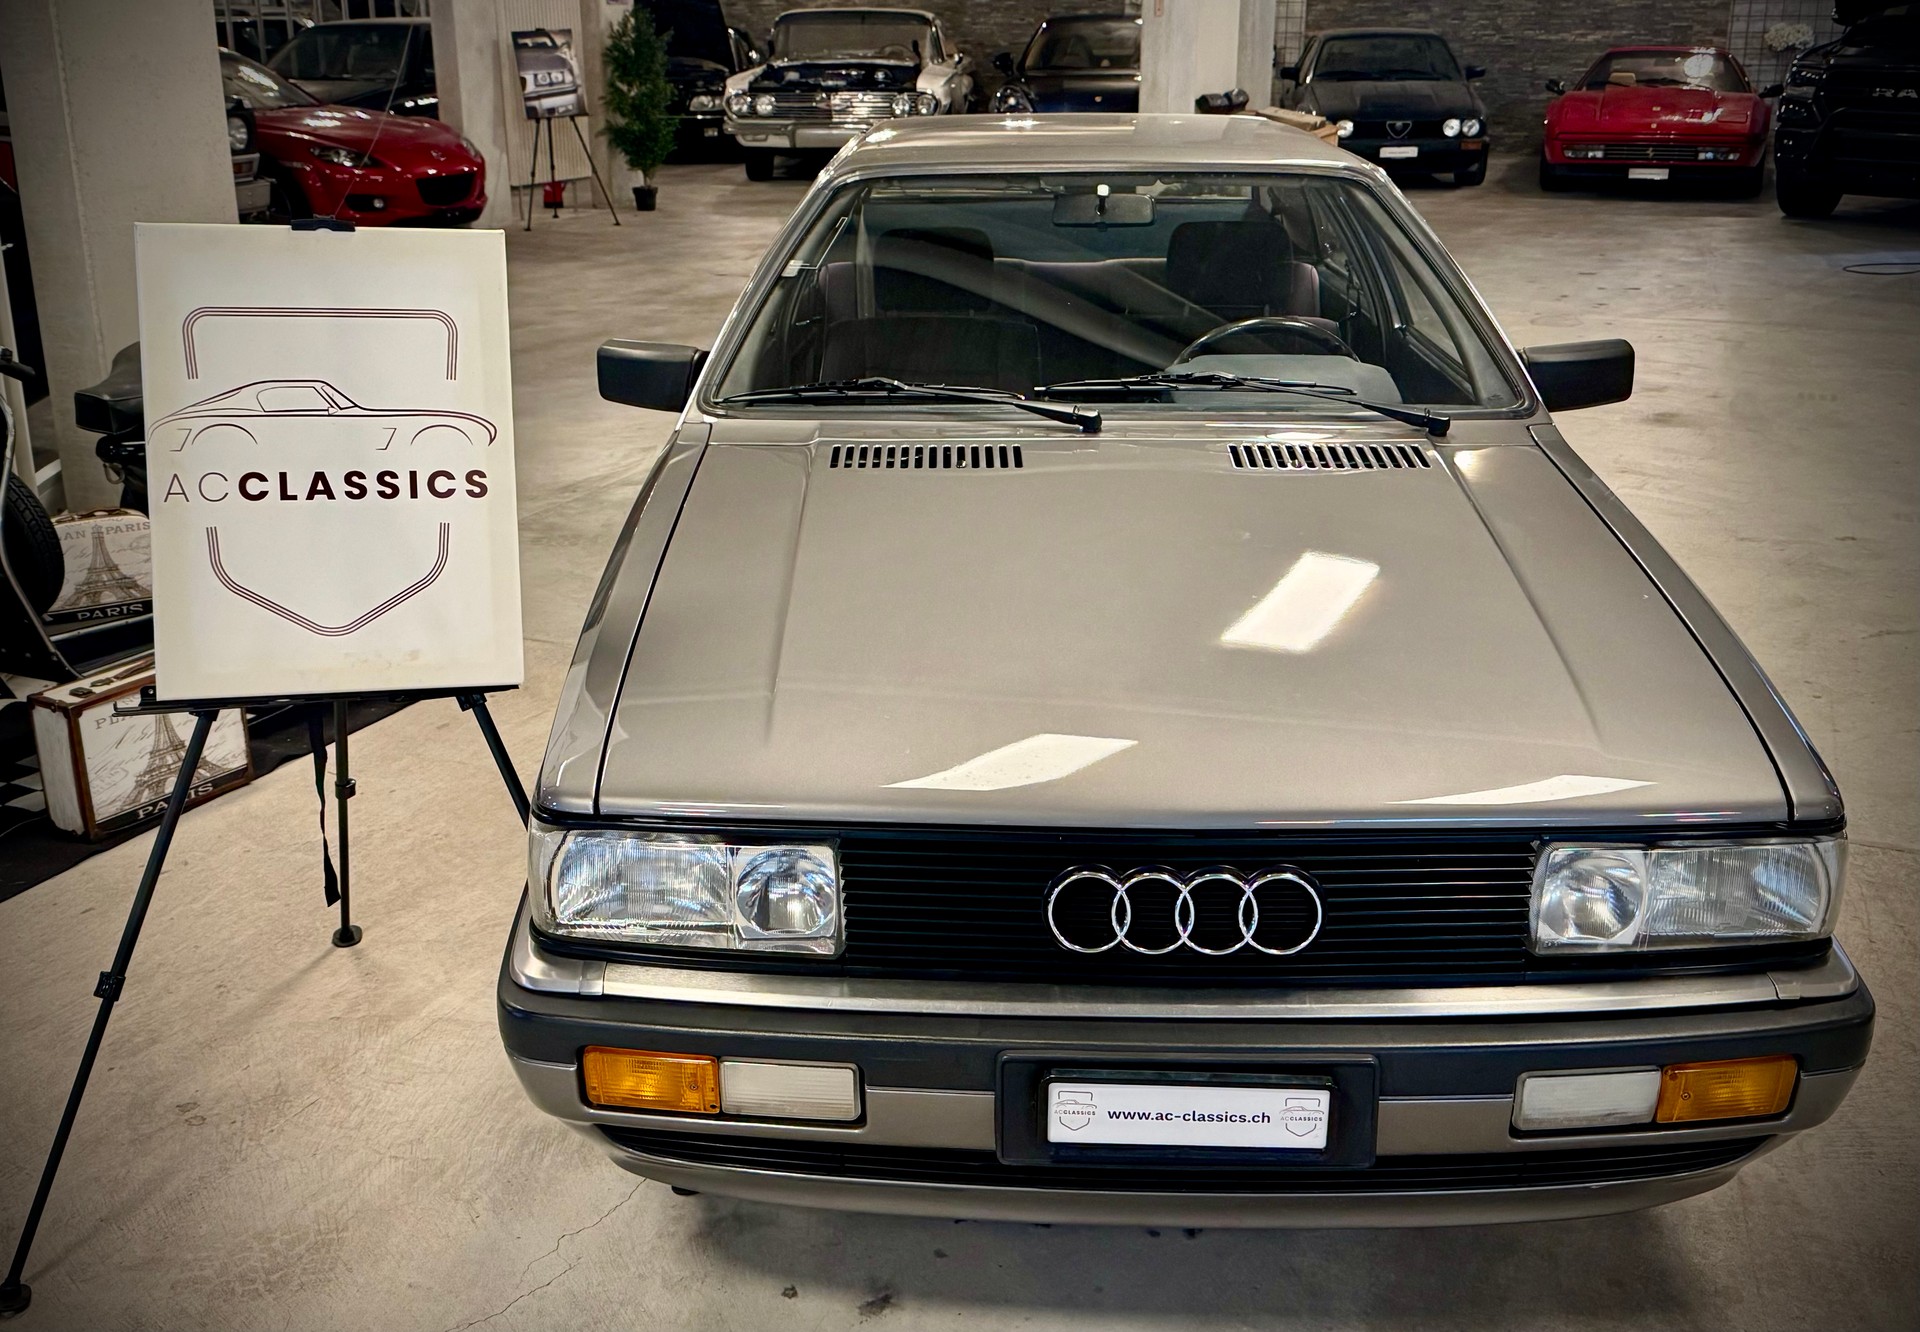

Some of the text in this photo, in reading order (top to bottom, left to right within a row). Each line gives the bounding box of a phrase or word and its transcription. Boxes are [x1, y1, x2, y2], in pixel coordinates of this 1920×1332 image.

[164, 469, 488, 502] ACCLASSICS
[105, 521, 151, 535] PARIS
[77, 603, 144, 620] PARIS
[136, 783, 214, 819] PAIS
[1107, 1109, 1271, 1123] www.ac-classics.ch
